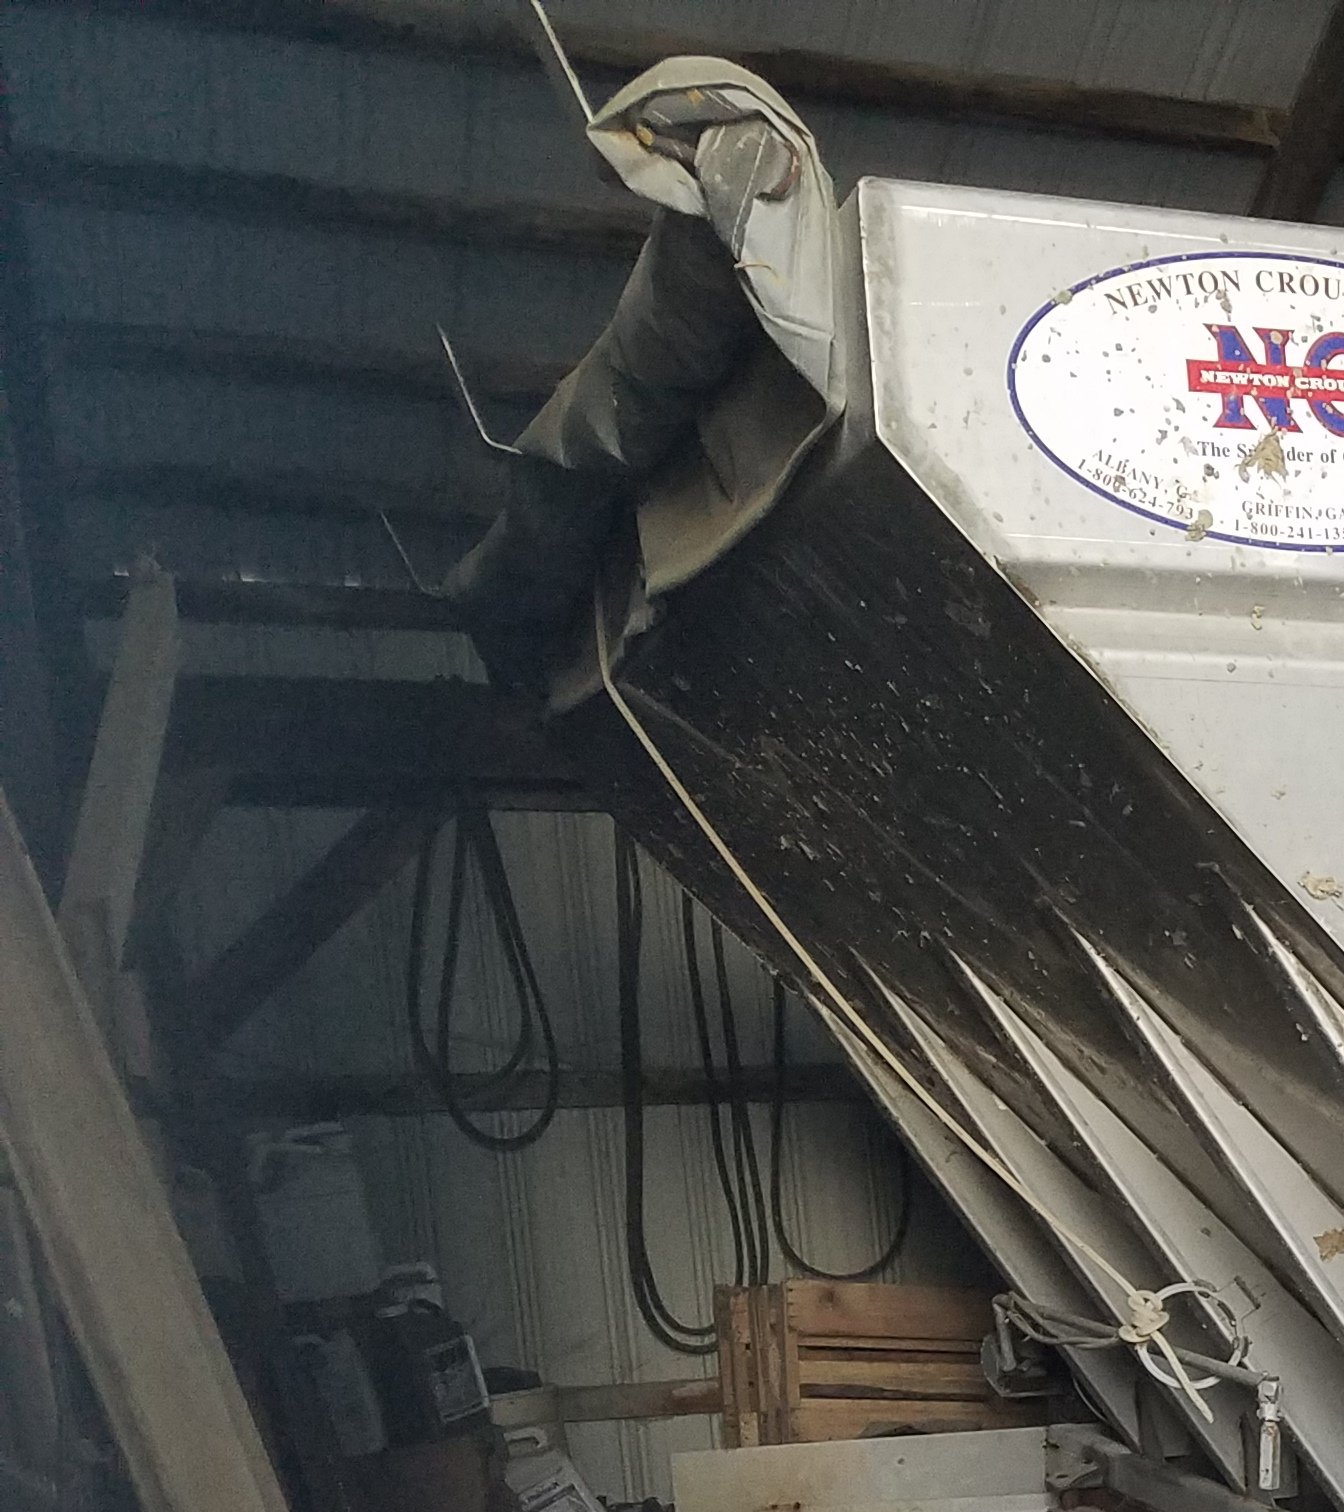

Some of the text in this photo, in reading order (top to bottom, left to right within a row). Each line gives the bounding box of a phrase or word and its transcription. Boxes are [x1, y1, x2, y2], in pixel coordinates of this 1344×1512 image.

[1104, 270, 1241, 315] NEWTON
[1200, 369, 1290, 388] NEWTON
[1197, 440, 1231, 458] The
[1236, 442, 1314, 463] Sder
[1320, 449, 1337, 464] of
[1078, 458, 1195, 520] 1-800-624-793
